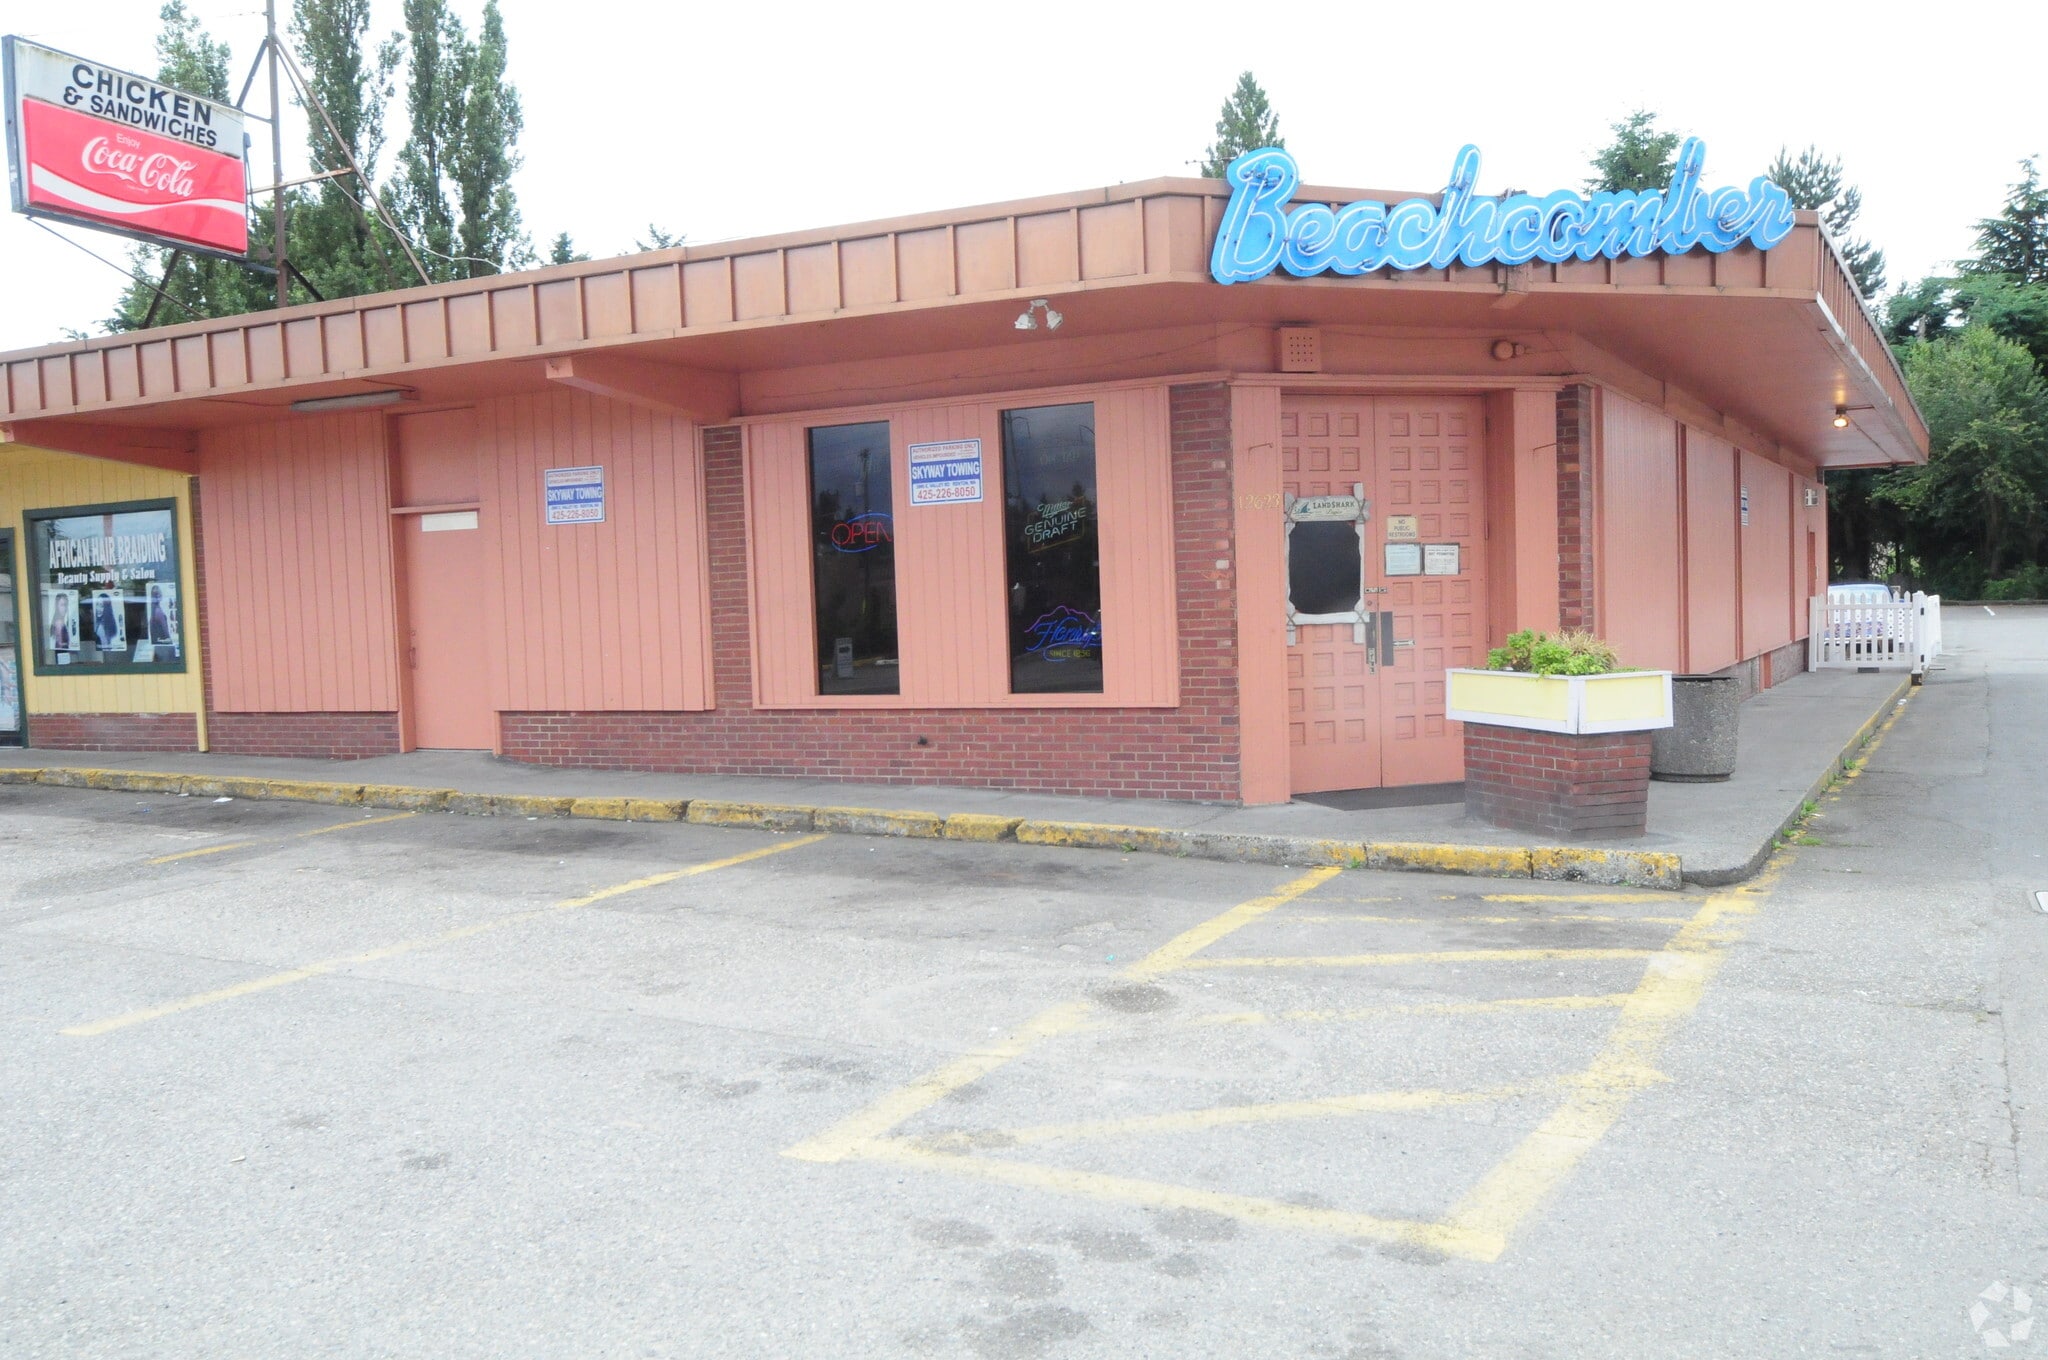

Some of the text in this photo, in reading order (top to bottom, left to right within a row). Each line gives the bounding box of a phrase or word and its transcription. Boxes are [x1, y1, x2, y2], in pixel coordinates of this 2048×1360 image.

[72, 64, 212, 126] CHICKEN
[63, 86, 217, 147] & SANDWICHES
[116, 133, 140, 149] Enjoy
[82, 137, 197, 197] Coca-Cola
[1211, 136, 1796, 286] Beachcomber
[912, 461, 980, 480] SKYWAY TOWING
[548, 486, 602, 502] SKYWAY TOWING
[917, 486, 976, 500] 425-226-8050
[1313, 501, 1355, 509] LANDSHARK
[1025, 507, 1086, 535] GENUINE
[1033, 520, 1078, 543] DRAFT
[832, 522, 893, 545] OPEN
[49, 532, 166, 569] AFRICAN HAIR BRAIDING
[57, 566, 155, 585] Beauty Supply & Salon
